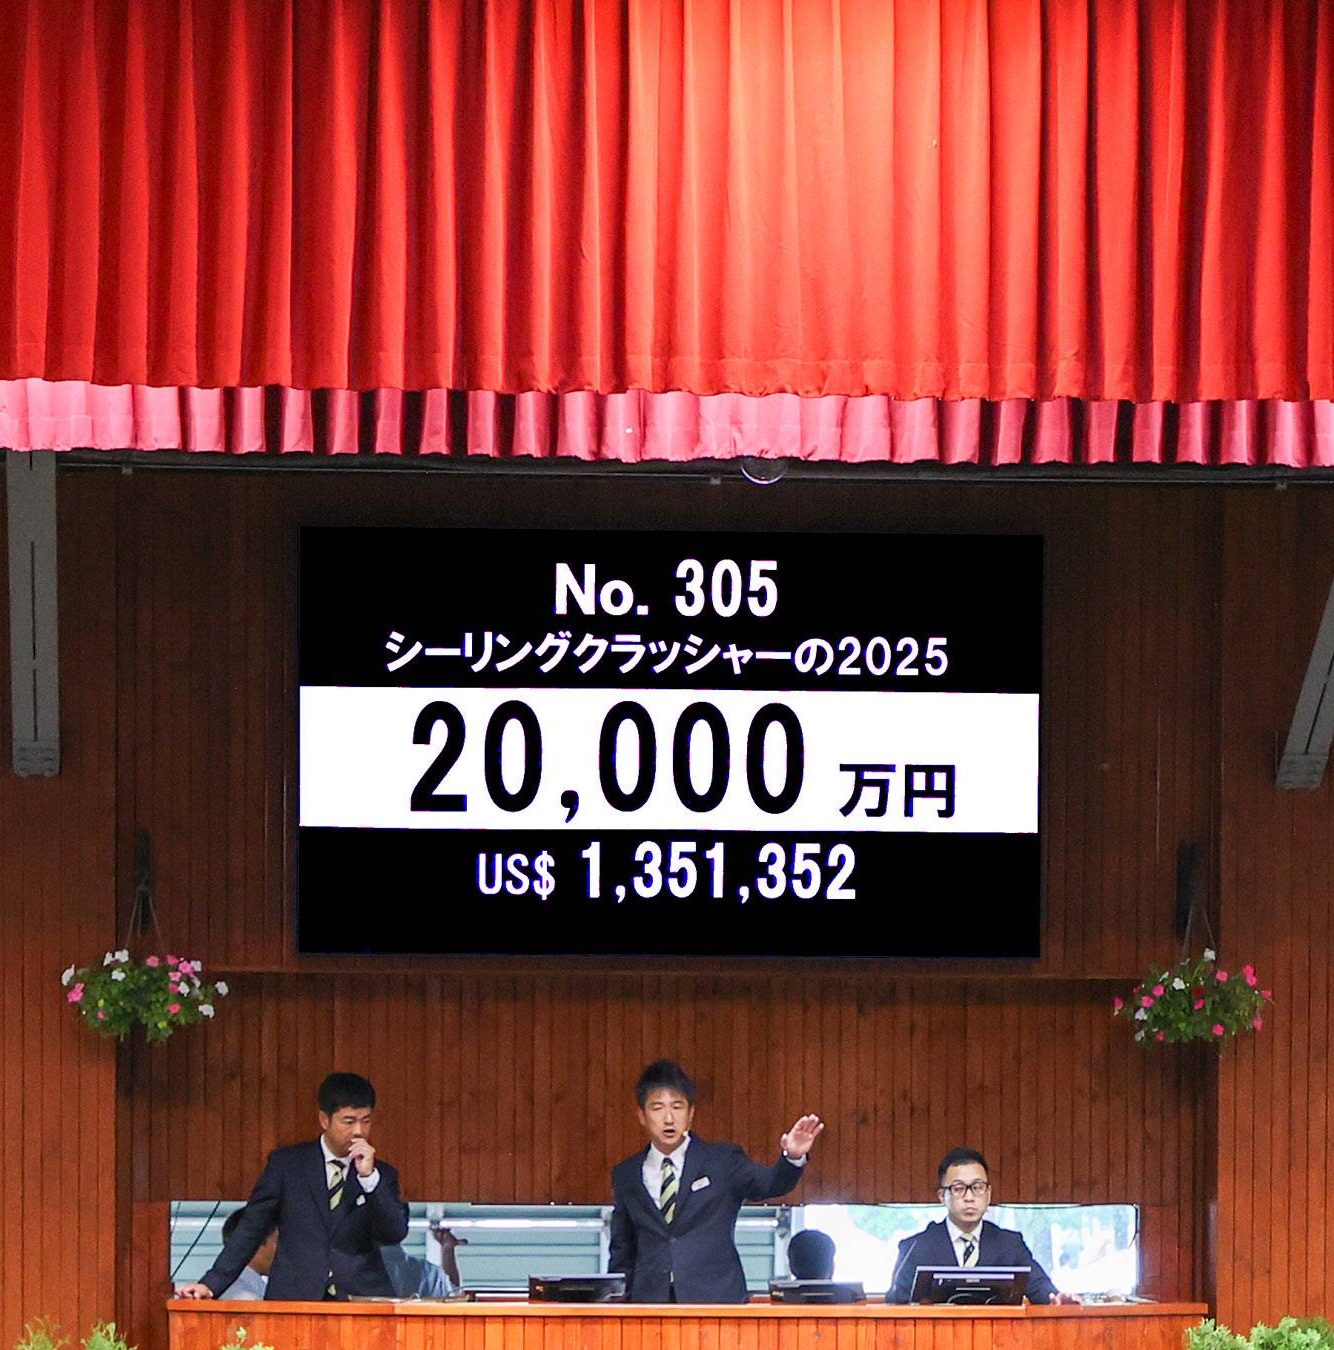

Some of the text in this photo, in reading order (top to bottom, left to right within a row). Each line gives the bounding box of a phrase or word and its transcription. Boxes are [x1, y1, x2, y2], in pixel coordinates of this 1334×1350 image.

[555, 558, 778, 618] No. 305
[385, 630, 949, 677] シーリングクラッシャーの2025
[410, 699, 956, 824] 20,000 万円
[478, 840, 856, 904] US$ 1,351,352
